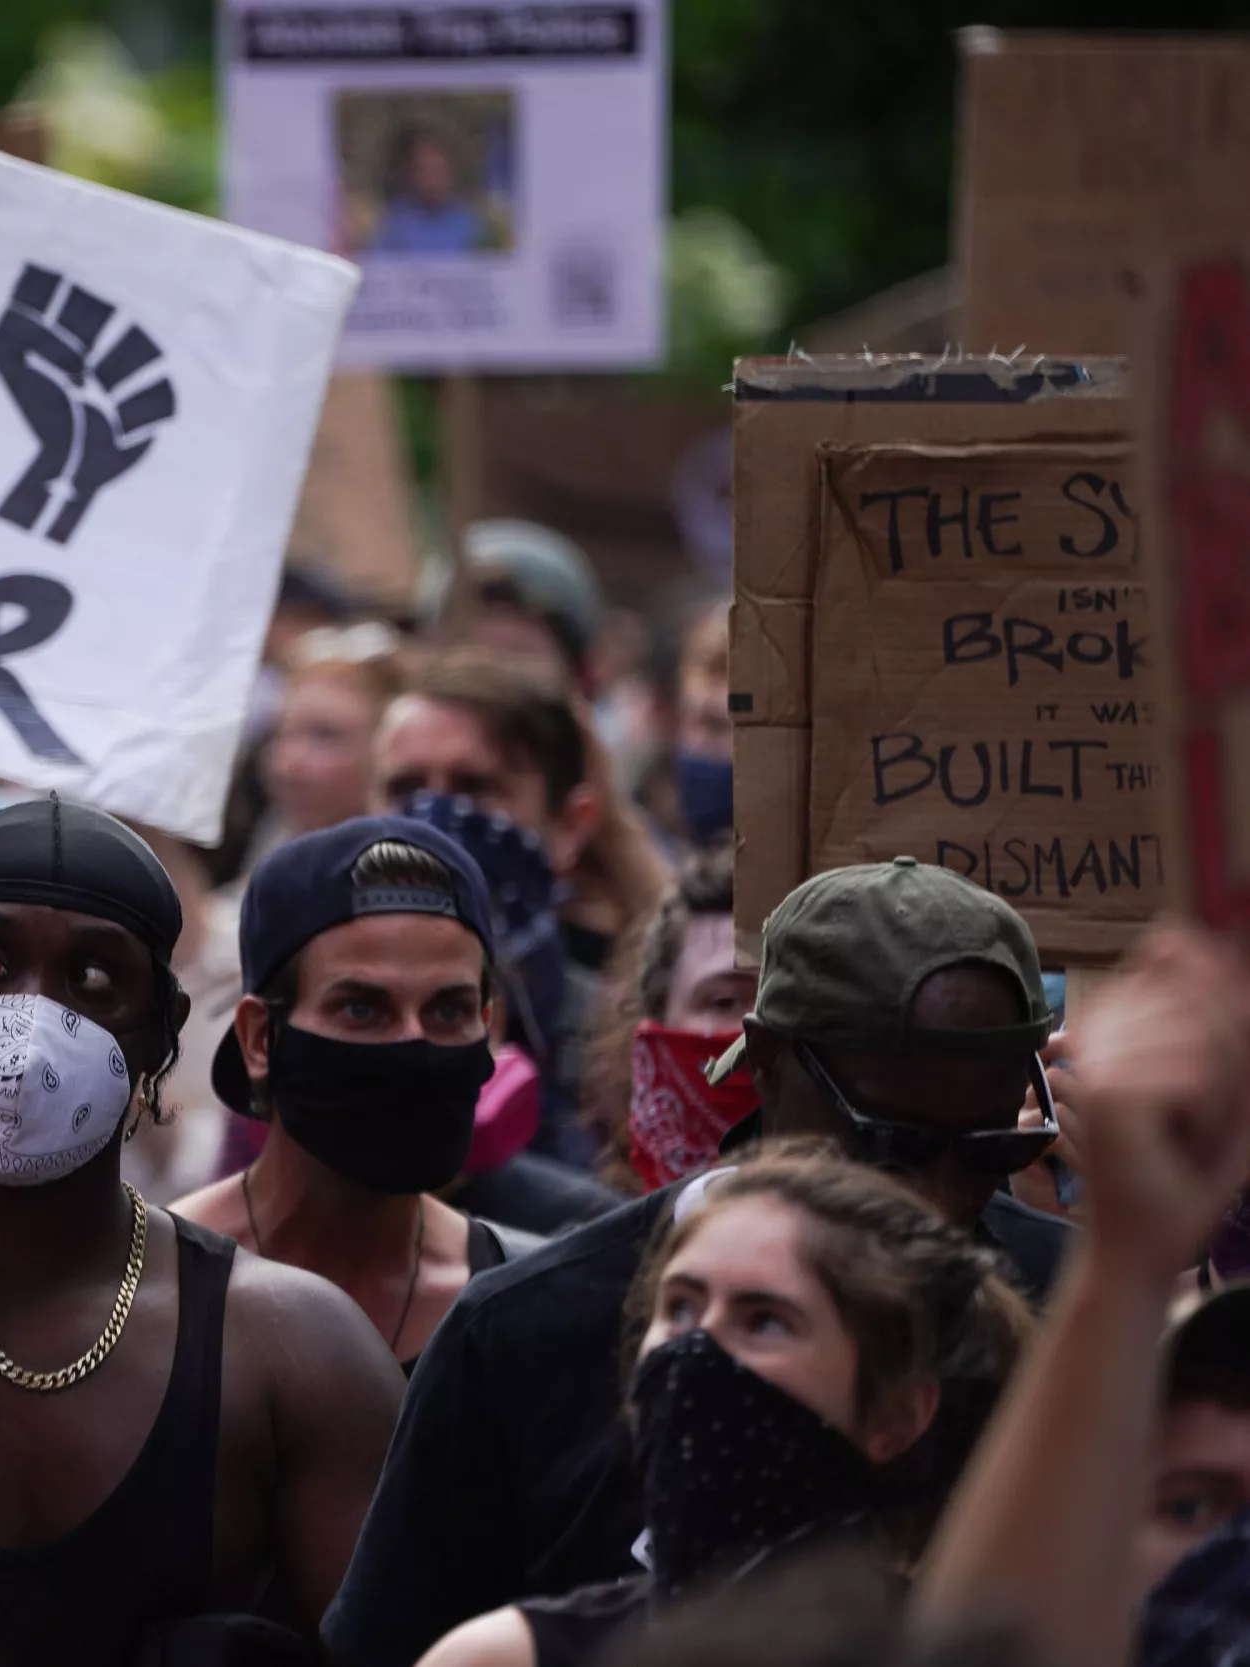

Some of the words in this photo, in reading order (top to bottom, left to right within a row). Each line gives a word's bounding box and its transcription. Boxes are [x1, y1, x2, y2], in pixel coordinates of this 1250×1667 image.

[859, 485, 1024, 575] THE
[1036, 704, 1060, 722] IT
[871, 731, 1108, 809] BUILT
